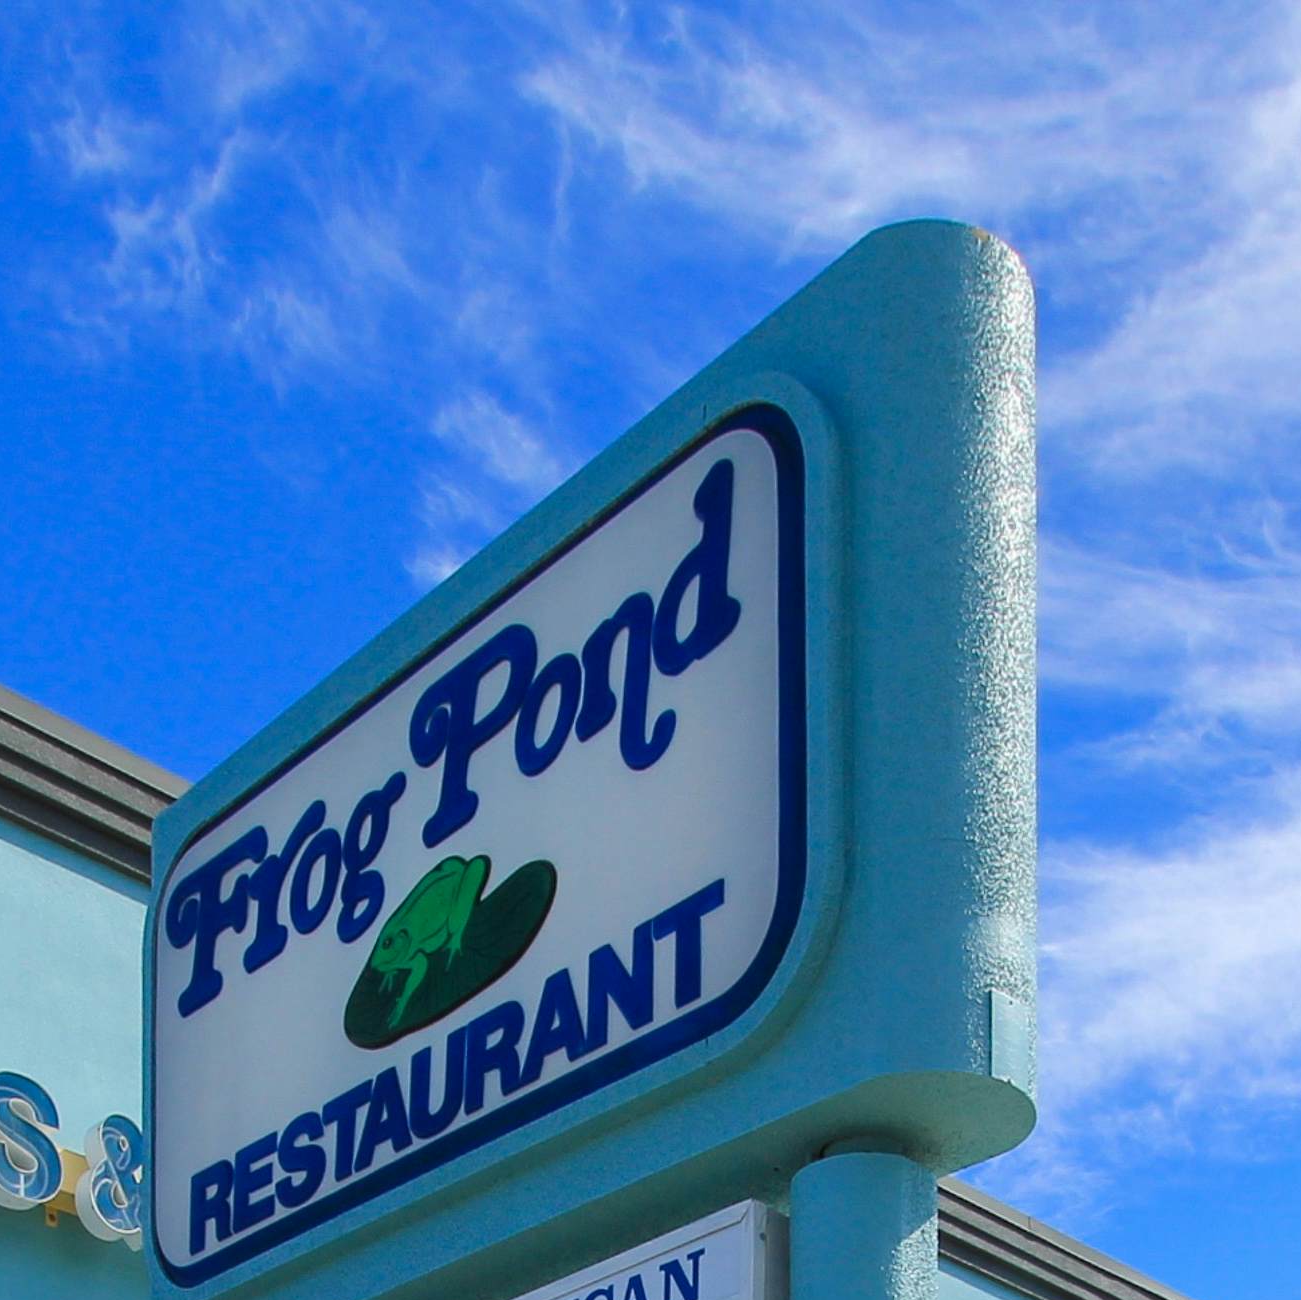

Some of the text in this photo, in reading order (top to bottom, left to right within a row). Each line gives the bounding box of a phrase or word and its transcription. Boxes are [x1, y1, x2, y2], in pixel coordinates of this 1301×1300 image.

[166, 458, 742, 1018] Frog Pond
[188, 878, 727, 1257] RESTAURANT
